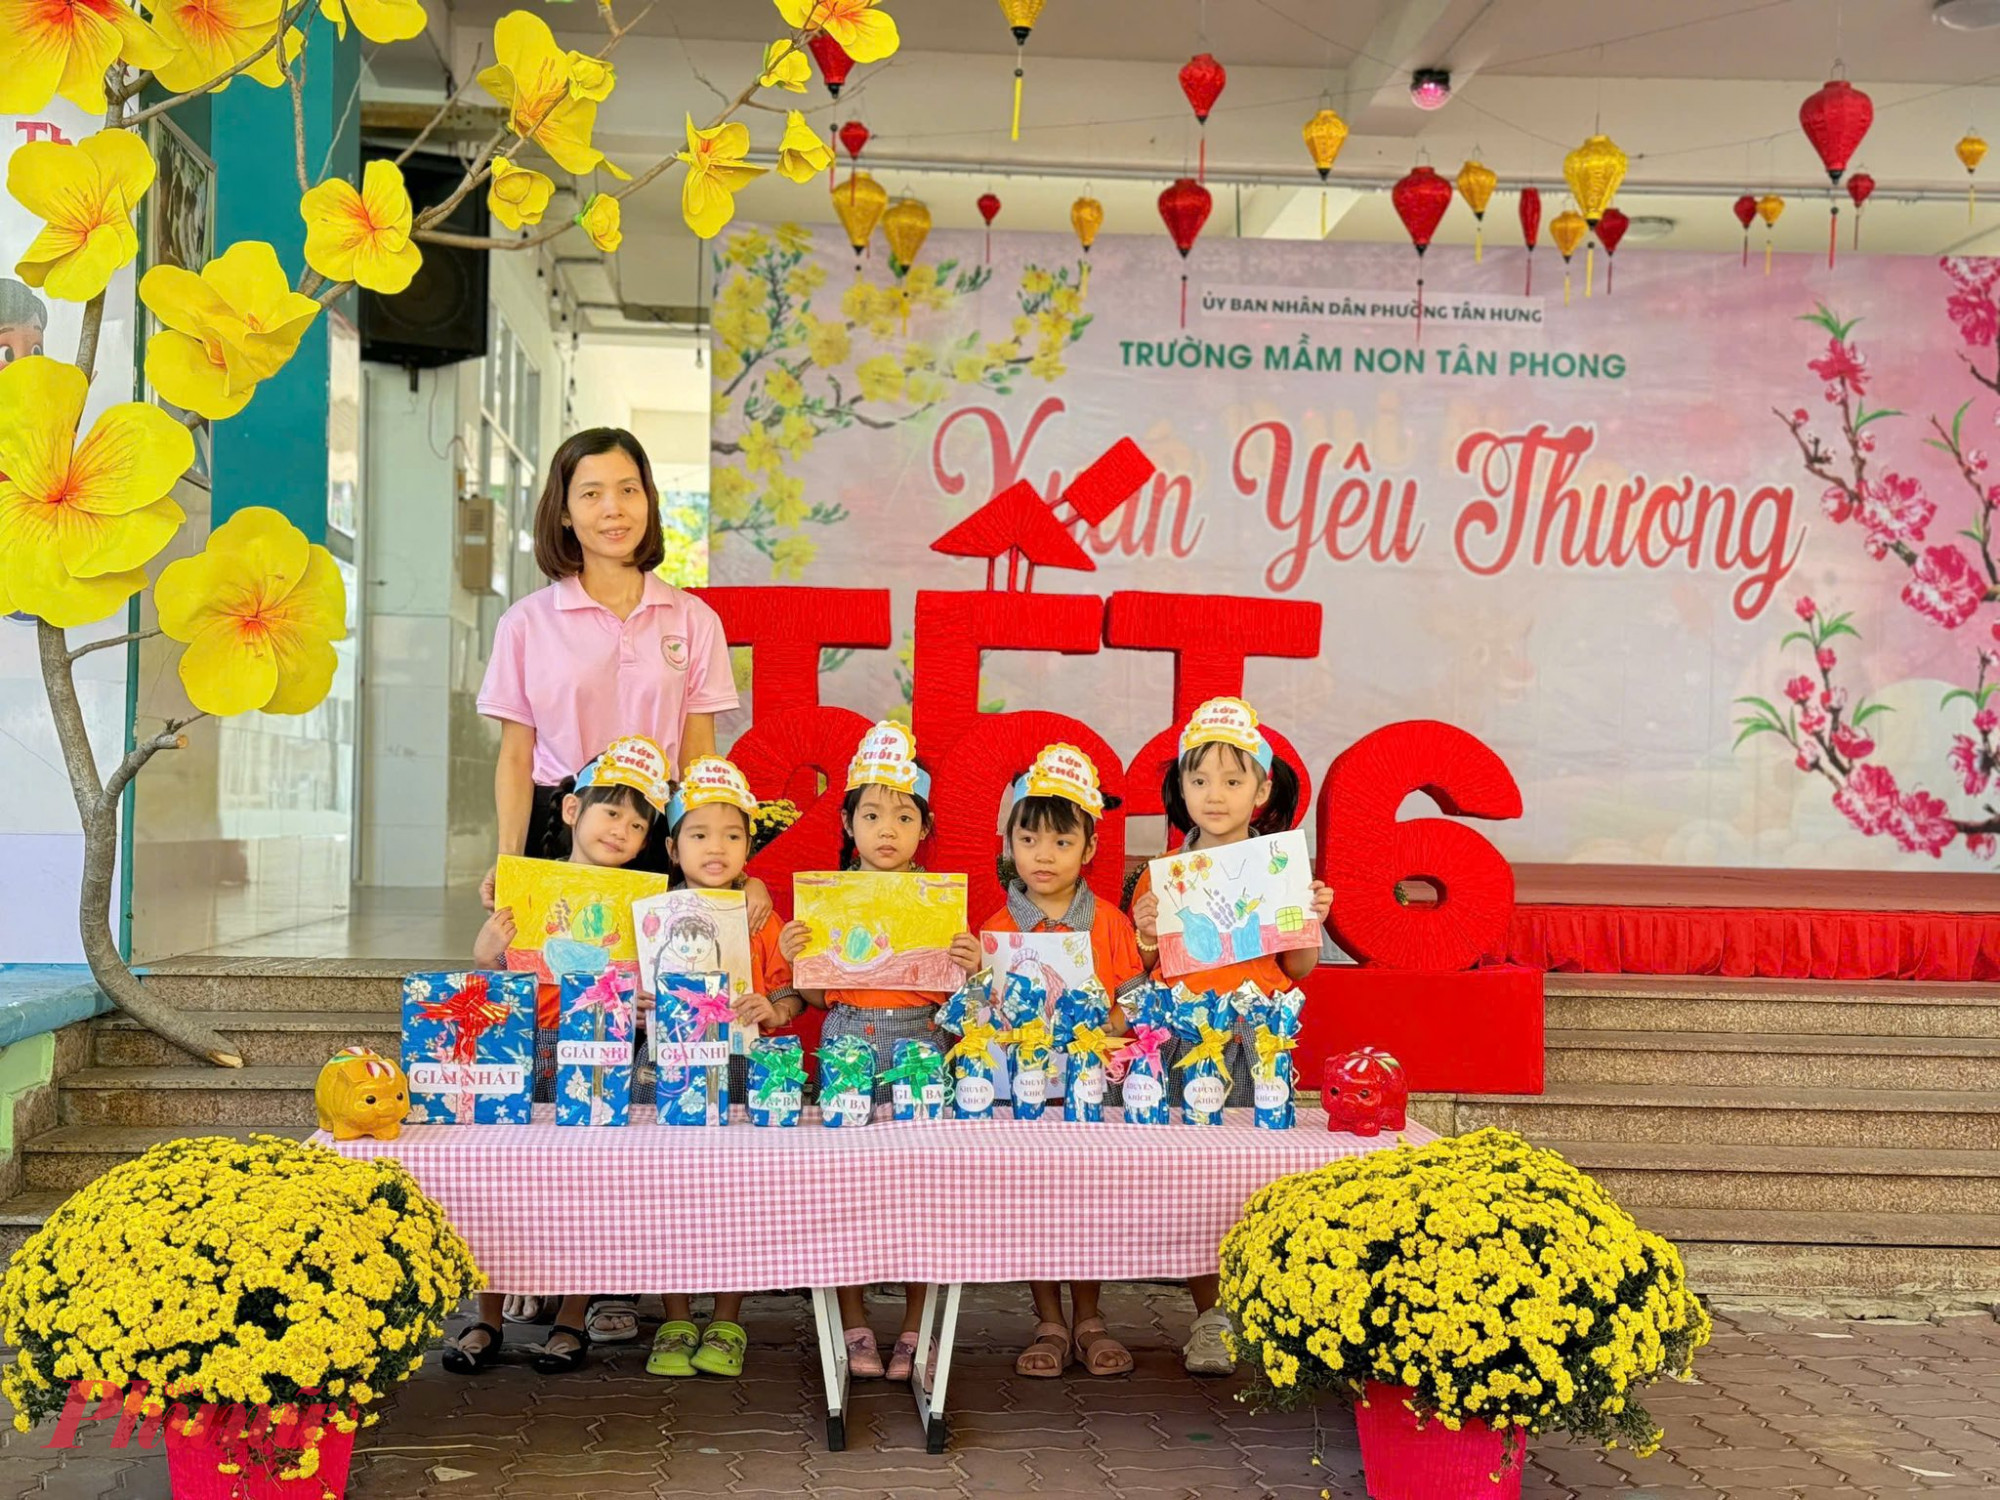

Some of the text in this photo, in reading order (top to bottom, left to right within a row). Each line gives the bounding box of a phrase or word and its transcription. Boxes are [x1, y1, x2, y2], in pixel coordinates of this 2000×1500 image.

[1203, 291, 1543, 323] ỦY BAN NHÂN DÂN PHƯỜNG TÂN HƯNG
[1120, 333, 1626, 379] TRƯỜNG MẦM NON TÂN PHONG
[1233, 421, 1424, 592] Yêu
[1455, 424, 1806, 621] Thương
